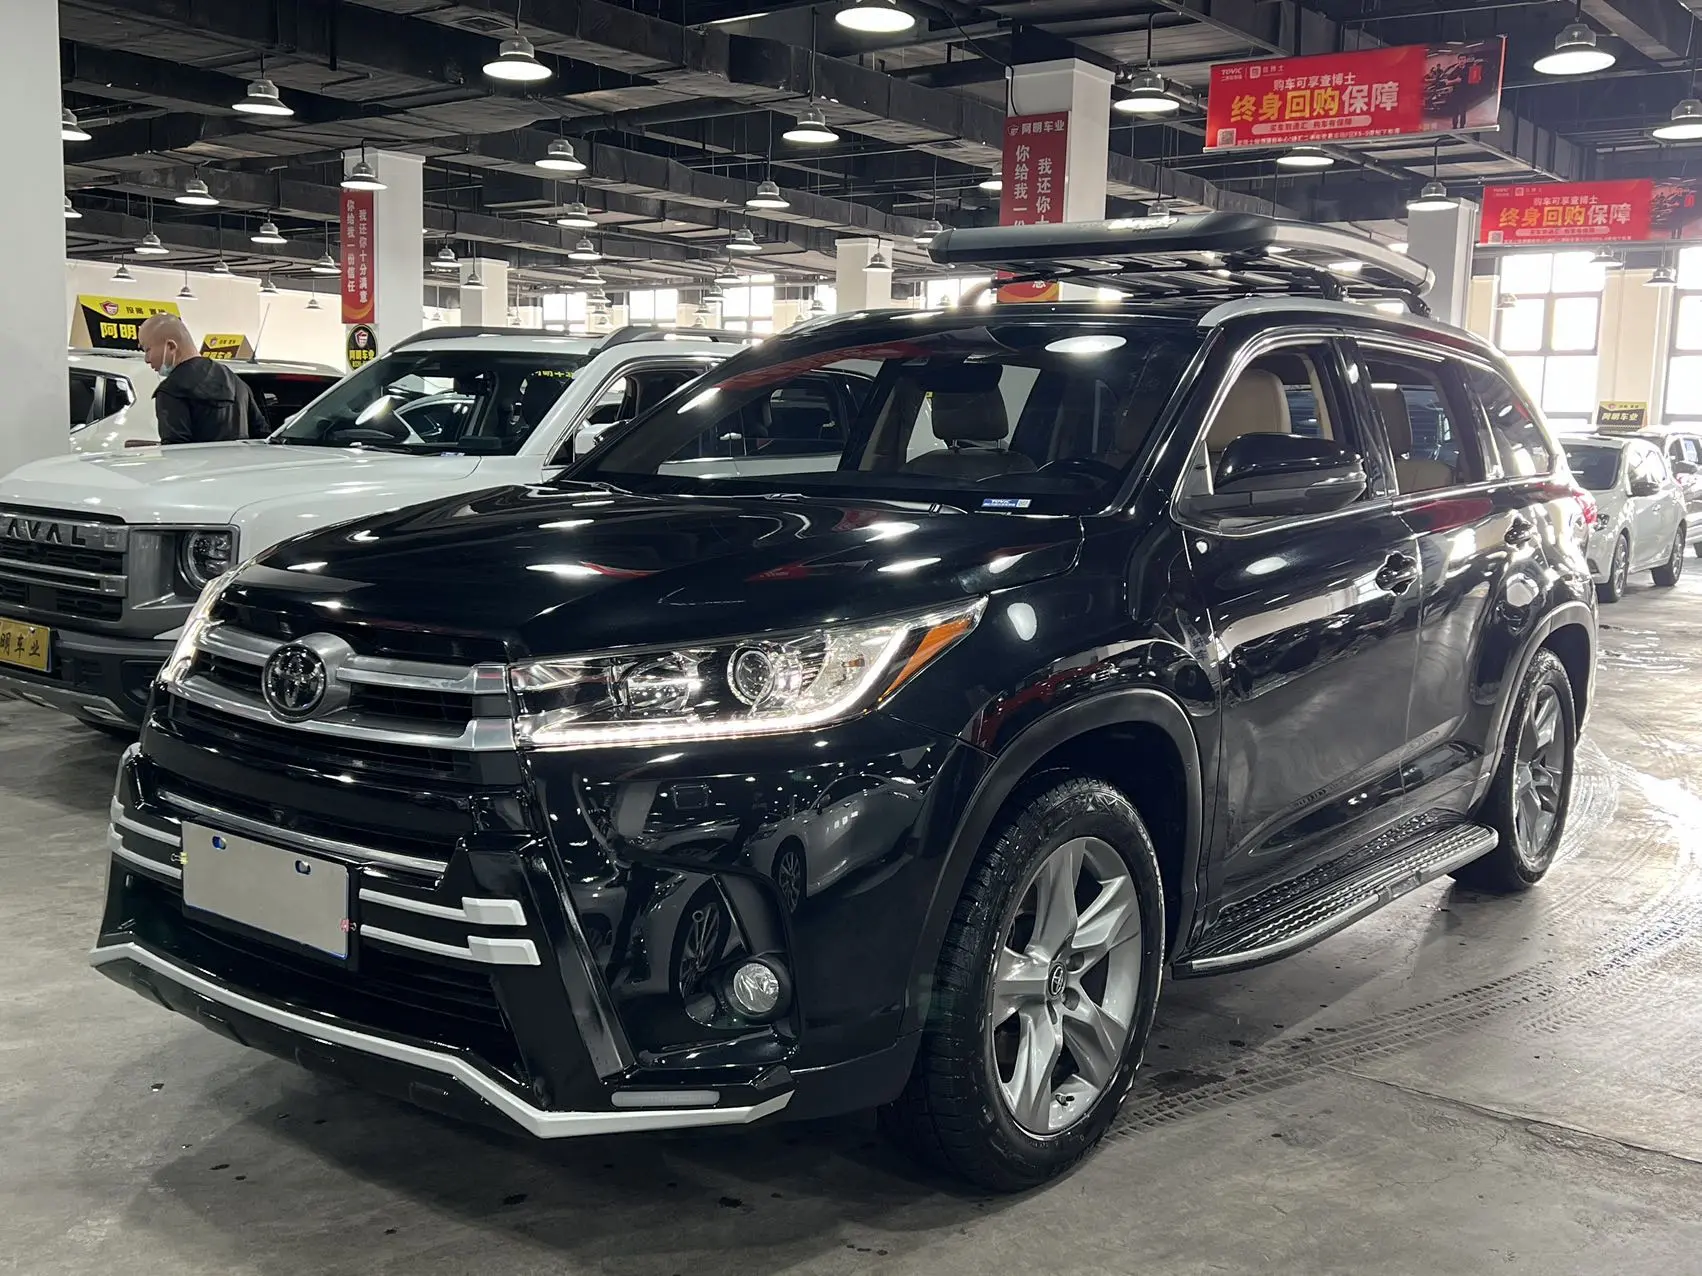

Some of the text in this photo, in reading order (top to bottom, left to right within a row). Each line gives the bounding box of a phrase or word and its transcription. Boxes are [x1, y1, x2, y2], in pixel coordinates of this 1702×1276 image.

[1273, 72, 1356, 91] 购车可享查博士
[1230, 81, 1399, 123] 终身回购保障
[1021, 119, 1065, 135] 阿明车业
[1498, 202, 1632, 228] 终身回购保障
[100, 322, 140, 340] 阿明
